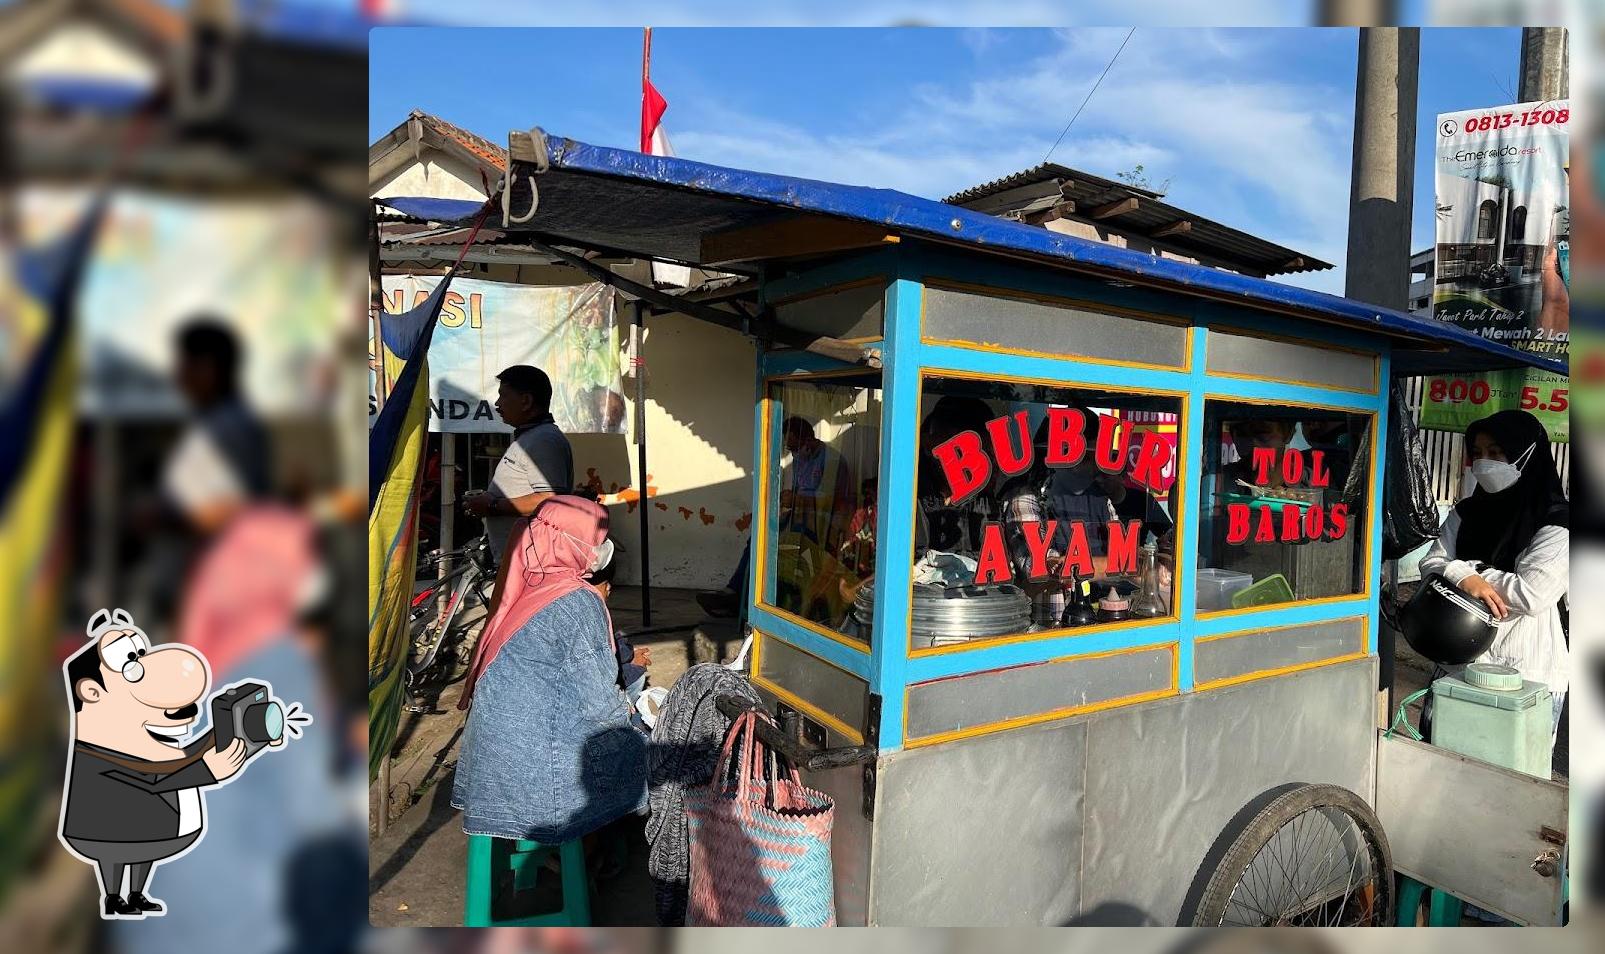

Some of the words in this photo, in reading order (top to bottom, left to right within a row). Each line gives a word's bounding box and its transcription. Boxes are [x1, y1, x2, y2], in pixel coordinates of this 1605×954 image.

[1464, 109, 1569, 133] 0813-1308
[1516, 310, 1525, 320] 2
[1481, 326, 1532, 339] Mewah
[1534, 327, 1545, 339] 2
[1511, 340, 1555, 352] SMART
[1429, 379, 1490, 405] 800
[1520, 386, 1569, 412] 5.5
[429, 399, 494, 421] NDA
[932, 407, 1173, 507] BUBUR
[1252, 447, 1330, 488] TOL
[1226, 502, 1349, 545] BAROS
[972, 520, 1142, 586] AYAM
